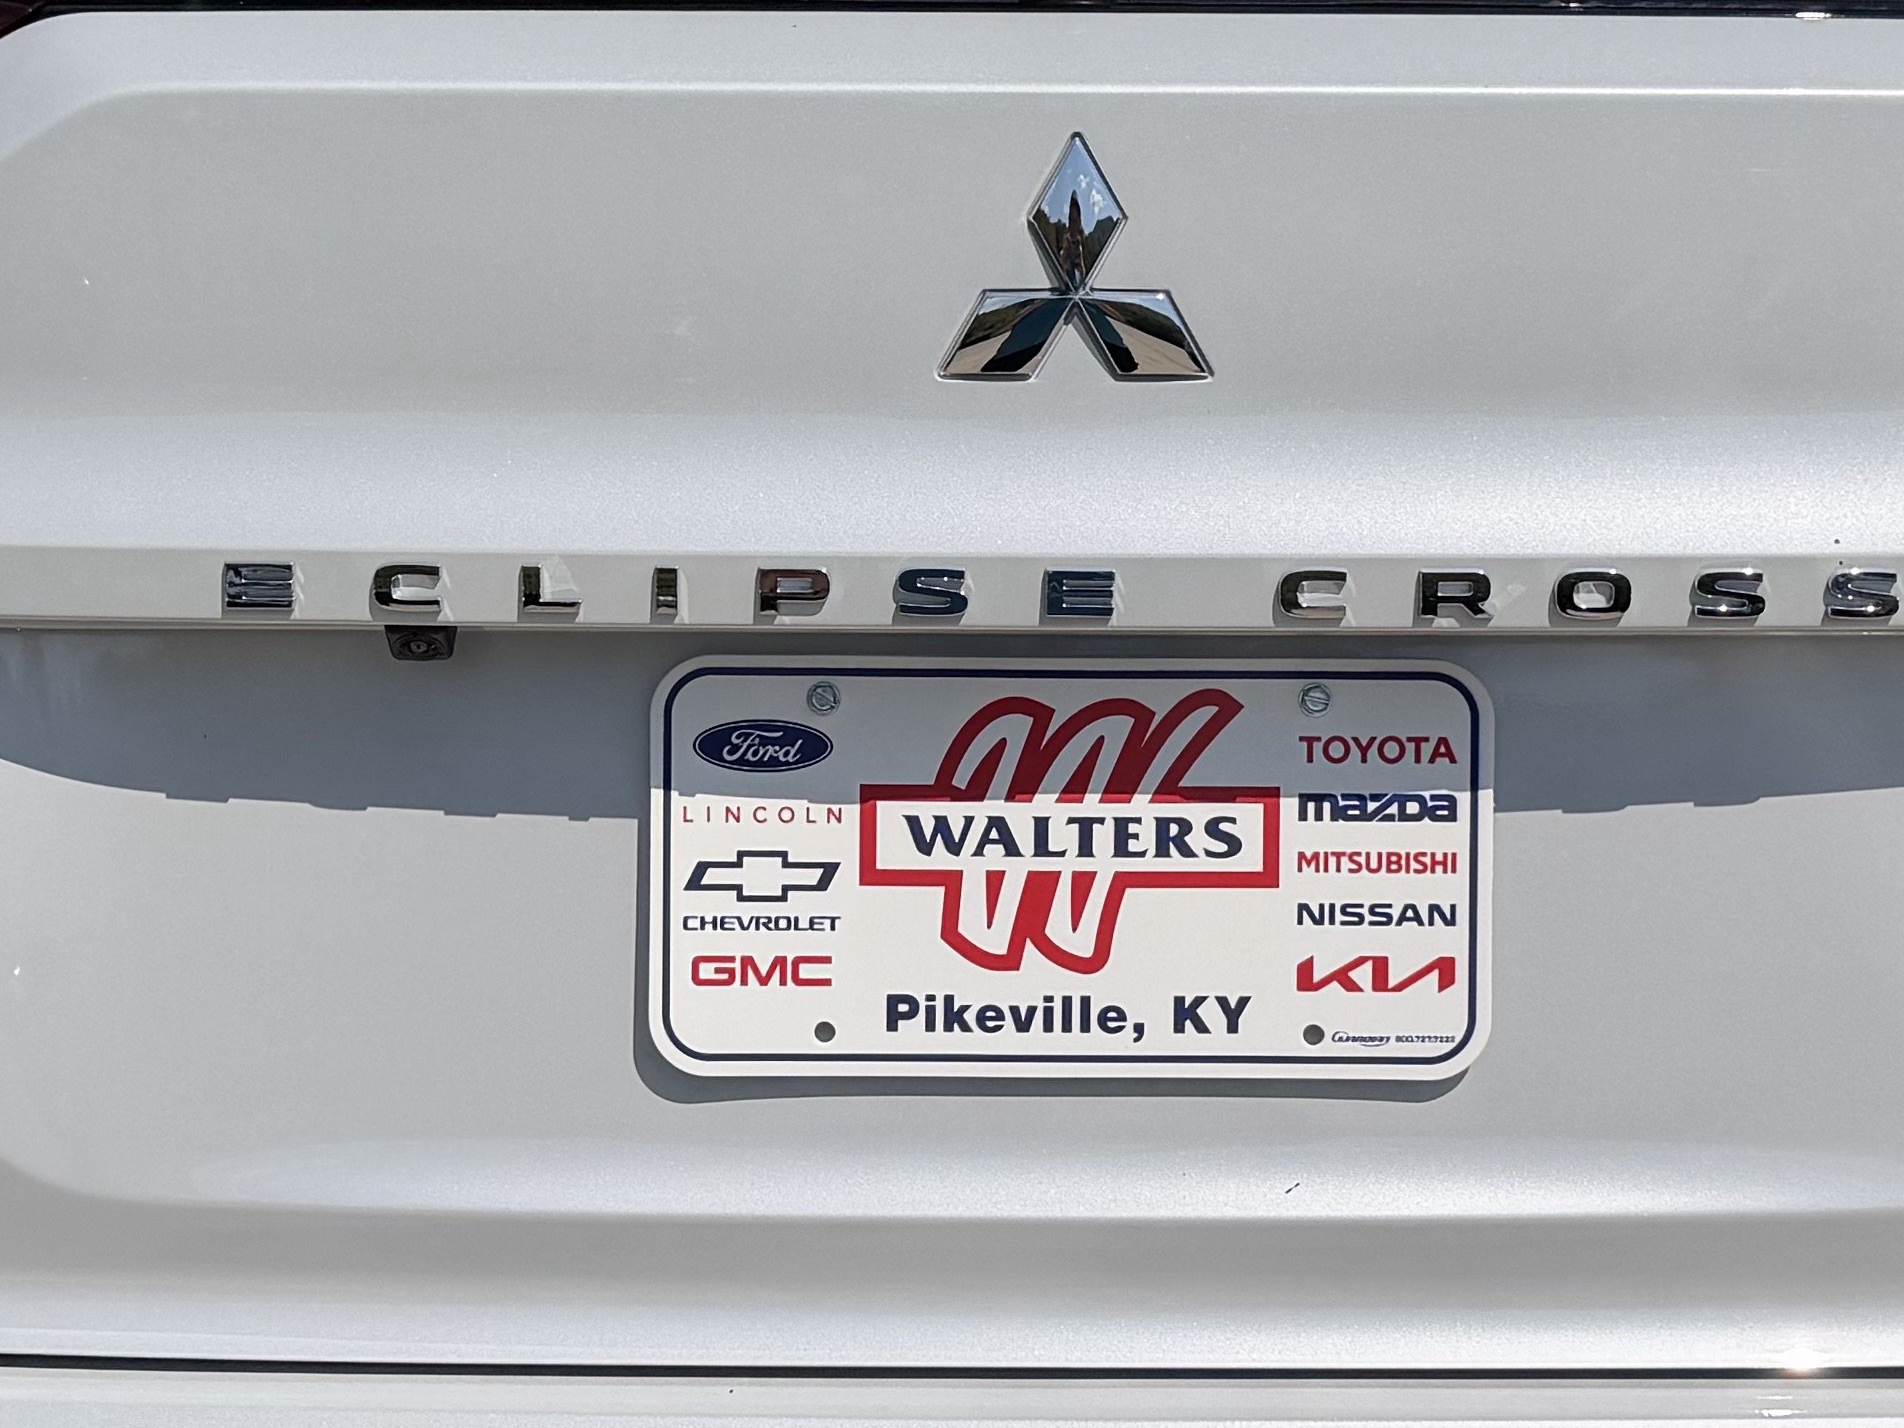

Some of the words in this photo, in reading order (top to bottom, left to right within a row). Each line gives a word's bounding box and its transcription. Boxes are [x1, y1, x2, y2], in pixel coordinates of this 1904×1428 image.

[222, 562, 1117, 618] ECLIPSE
[1279, 567, 1900, 620] CROSS
[722, 728, 804, 763] Ford
[1299, 736, 1458, 765] TOYOTA
[682, 806, 843, 825] LINCOLN
[902, 814, 1243, 859] WALTERS
[1296, 850, 1458, 875] MITSUBISHI
[682, 915, 842, 932] CHEVROLET
[1296, 902, 1458, 927] NISSAN
[690, 955, 833, 988] GMC
[885, 993, 1147, 1044] Pikeville,
[1172, 995, 1253, 1035] KY
